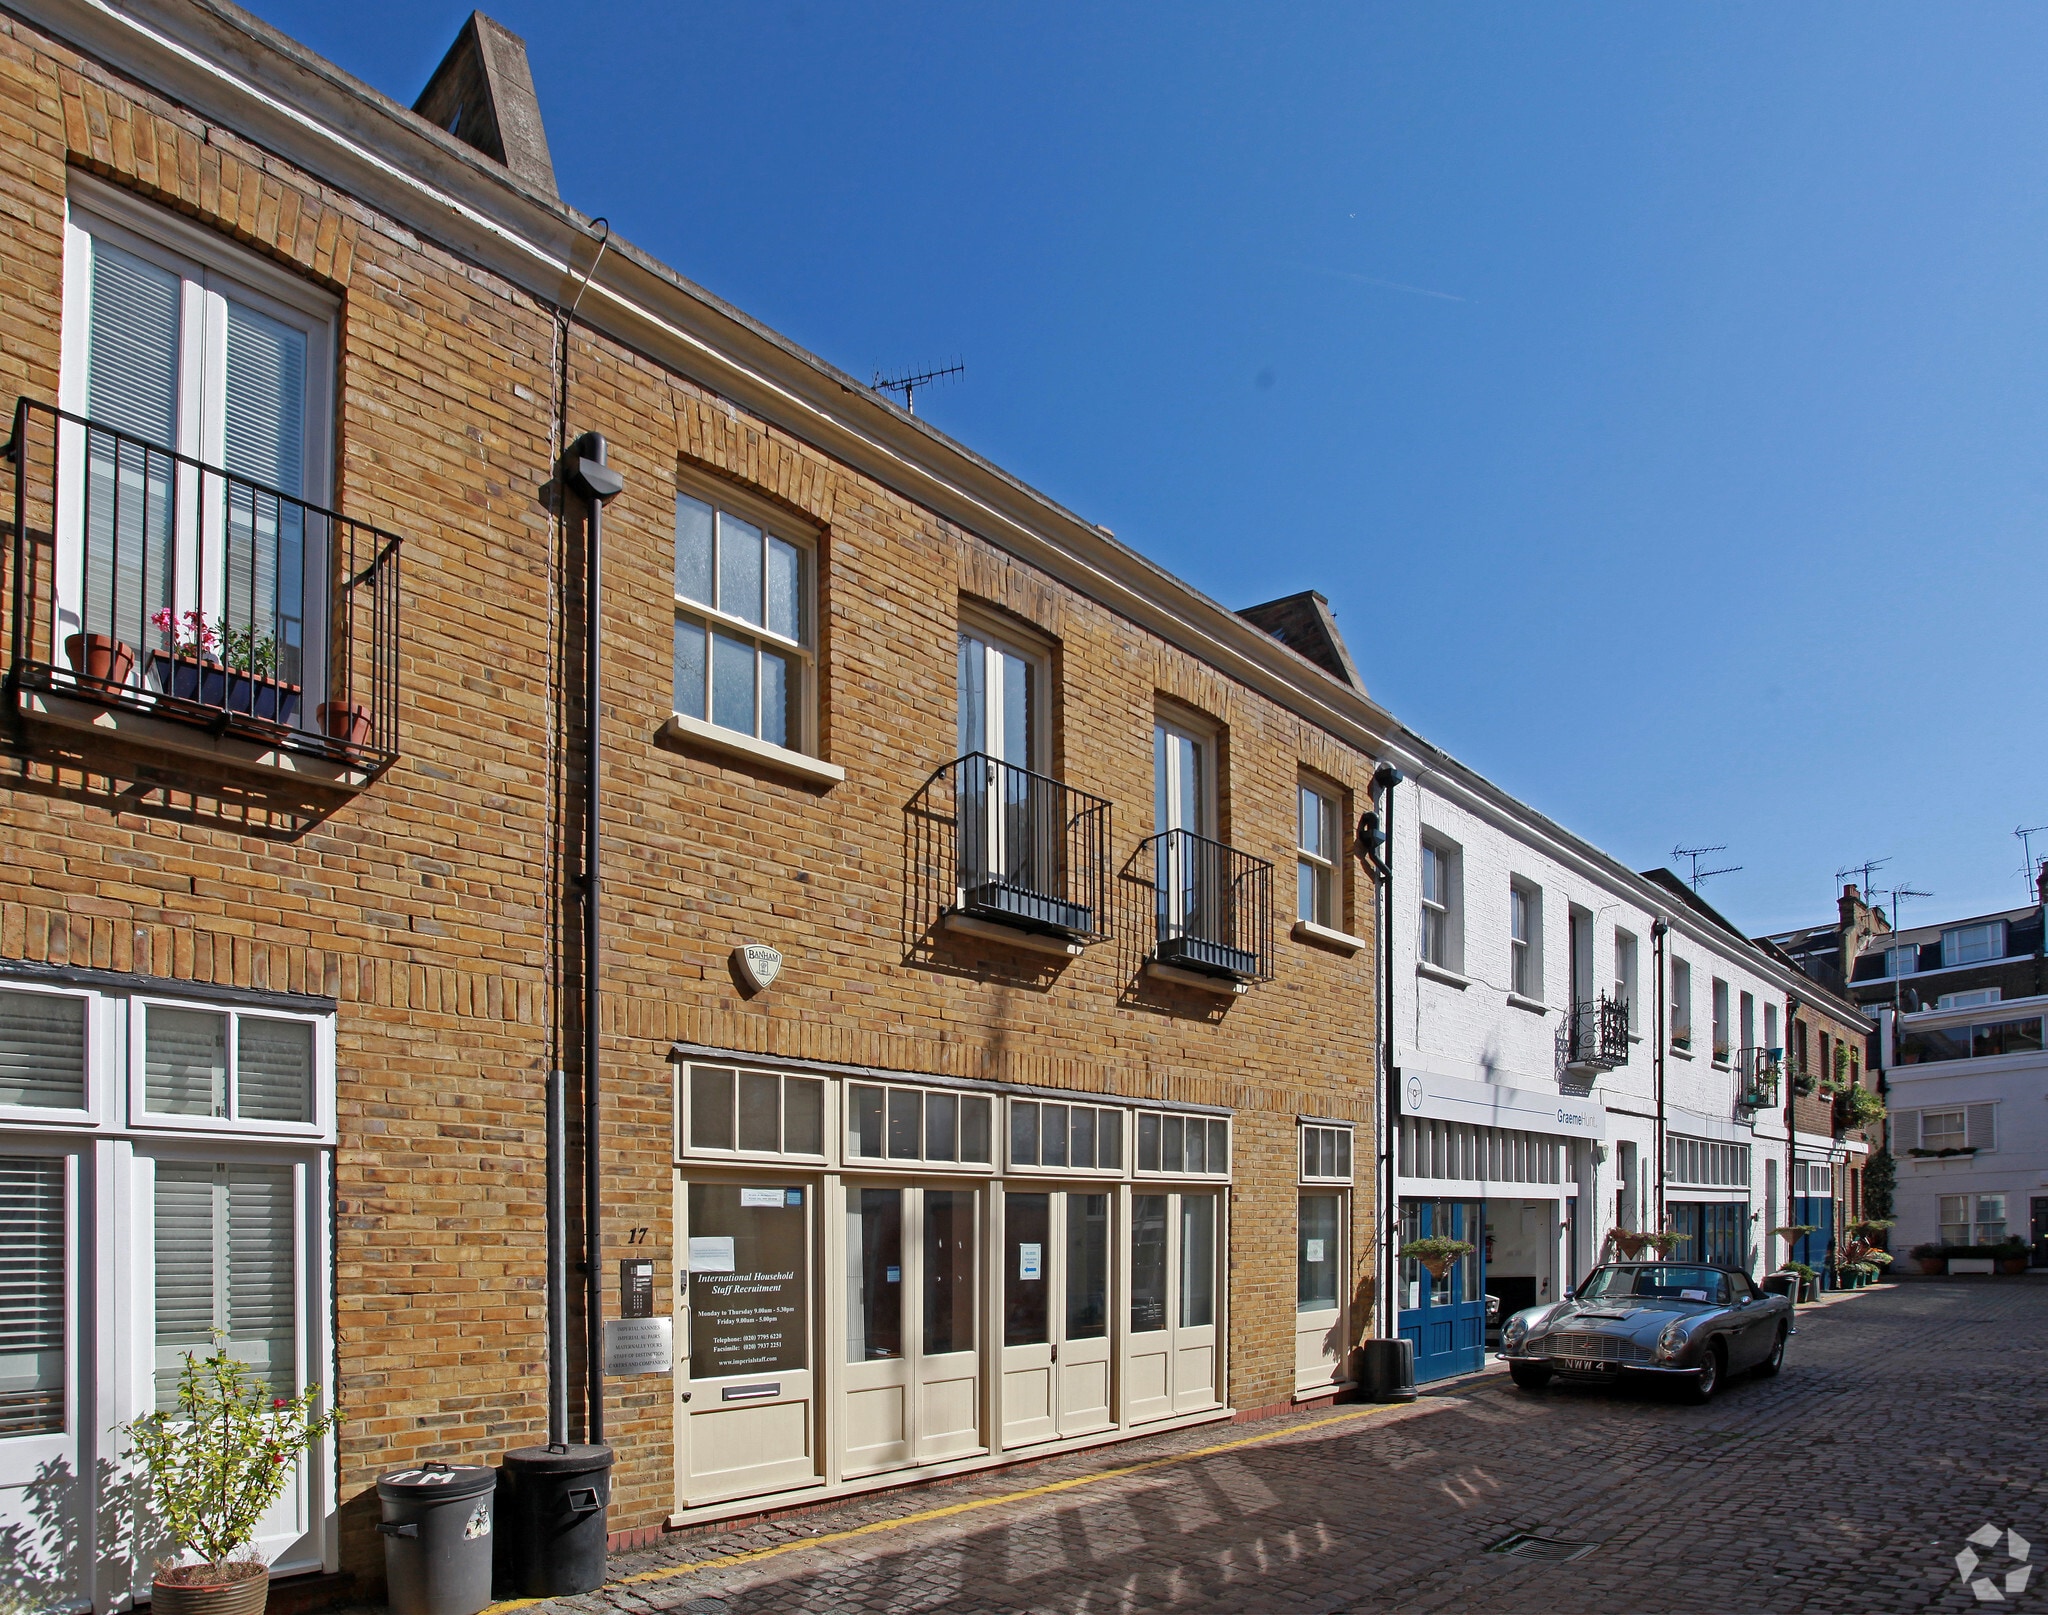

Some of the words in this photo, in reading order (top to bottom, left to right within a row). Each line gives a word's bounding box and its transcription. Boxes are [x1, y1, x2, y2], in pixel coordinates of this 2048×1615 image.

[749, 950, 778, 962] BANHAM
[627, 1227, 648, 1245] 17
[698, 1273, 752, 1283] International
[753, 1271, 794, 1281] Household
[711, 1284, 734, 1296] Staff
[734, 1283, 782, 1294] Recruitment
[698, 1310, 720, 1318] Monday
[717, 1318, 735, 1326] Friday
[713, 1336, 742, 1344] Telephone:
[713, 1345, 740, 1353] Facsimile:
[639, 1359, 669, 1367] COMPANIONS
[718, 1356, 778, 1365] www.imperialstaff.com
[1564, 1359, 1592, 1370] NWW
[1595, 1361, 1604, 1372] 4
